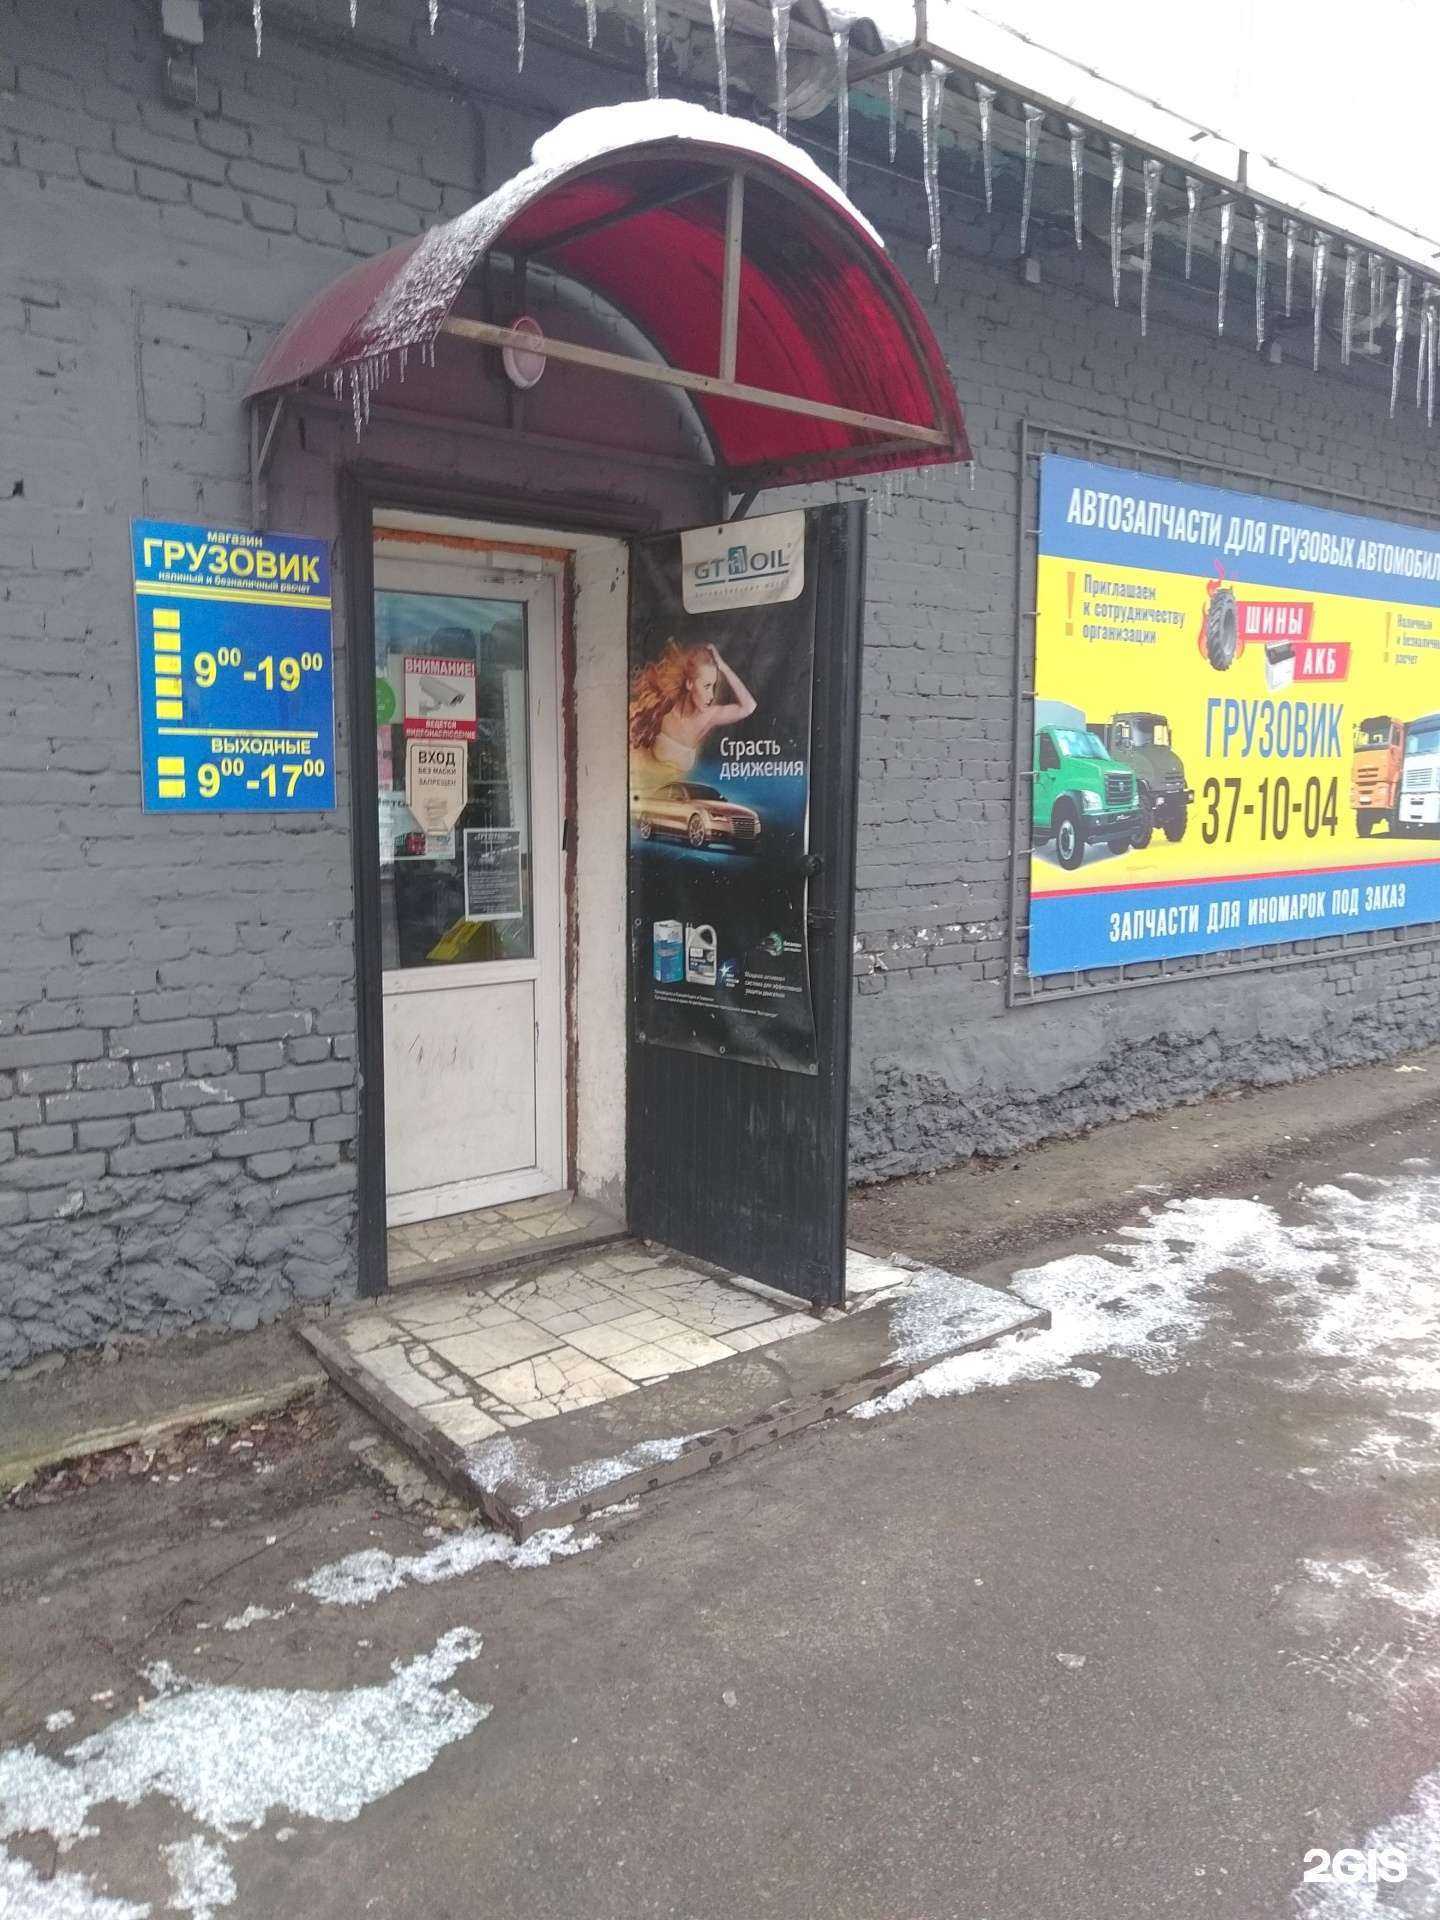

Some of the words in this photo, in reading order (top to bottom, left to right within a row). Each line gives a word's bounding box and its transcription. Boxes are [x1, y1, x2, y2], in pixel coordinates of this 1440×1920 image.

[207, 531, 263, 547] магазин
[1067, 487, 1221, 548] АВТОЗАПЧАСТИ
[1224, 516, 1264, 555] ДЛЯ
[1270, 523, 1354, 568] ГРУЗОВЫХ
[143, 537, 321, 584] ГРУЗОВИК
[695, 559, 724, 579] GT
[750, 549, 789, 571] OIL
[1084, 573, 1156, 600] Приглашаем
[1095, 603, 1185, 629] сотрудничеству
[1245, 605, 1303, 635] ШИНЫ
[1083, 625, 1156, 645] организации
[405, 658, 475, 678] ВНИМАНИЕ!
[1303, 647, 1337, 675] АКБ
[1206, 698, 1343, 759] ГРУЗОВИК
[211, 737, 312, 756] ВЫХОДНЫЕ
[418, 751, 456, 767] ВХОД
[720, 737, 781, 758] Страсть
[720, 761, 804, 780] движения
[1201, 776, 1338, 845] 37-10-04
[1109, 904, 1199, 942] ЗАПЧАСТИ
[1207, 900, 1240, 934] ДЛЯ
[1248, 893, 1326, 926] ИНОМАРОК
[1332, 888, 1359, 917] ПОД
[1365, 883, 1406, 910] ЗАКАЗ
